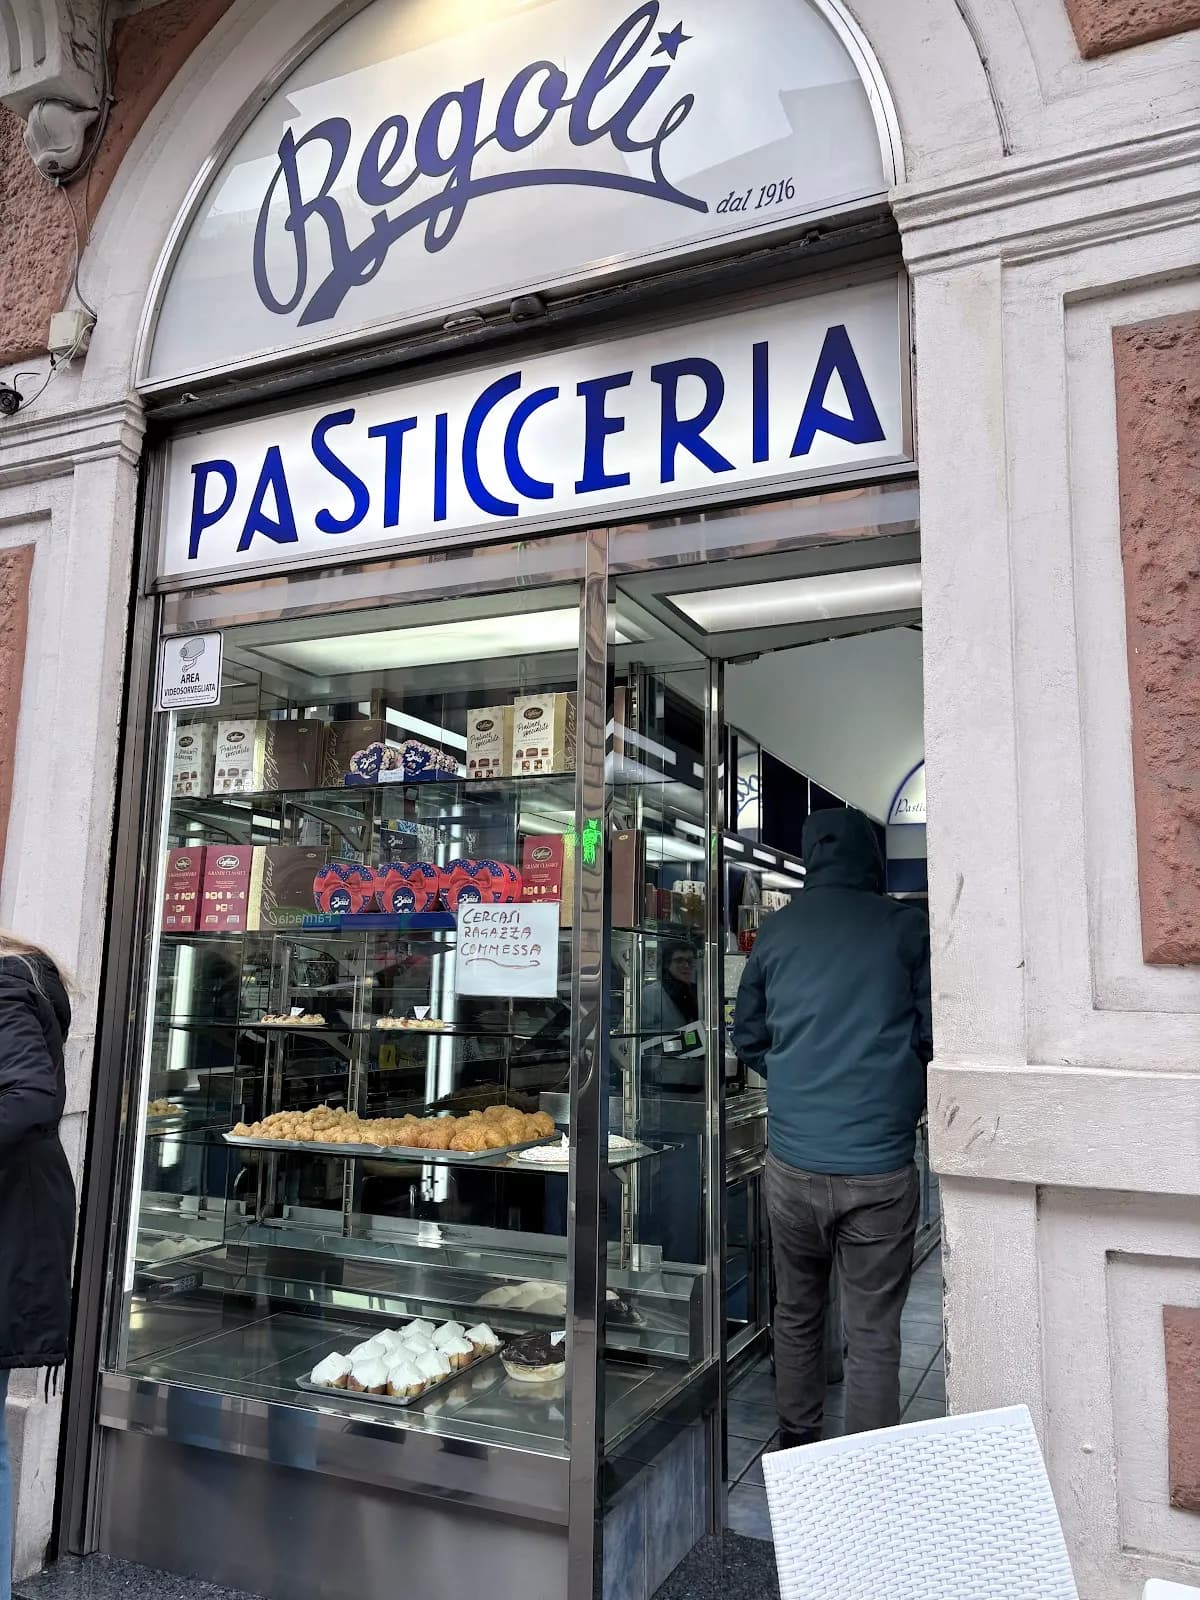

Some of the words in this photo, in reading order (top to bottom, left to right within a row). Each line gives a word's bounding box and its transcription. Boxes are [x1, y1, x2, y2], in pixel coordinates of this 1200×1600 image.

[253, 0, 708, 327] Regoli
[716, 188, 753, 214] dal
[755, 177, 795, 209] 1916
[188, 324, 886, 559] PASTICCERIA
[180, 673, 200, 684] AREA
[164, 683, 216, 697] VIDEOSORVEGLIATA
[462, 908, 520, 924] CERCASI
[463, 926, 531, 940] RAGAZZA
[460, 942, 541, 956] COMMESSA
